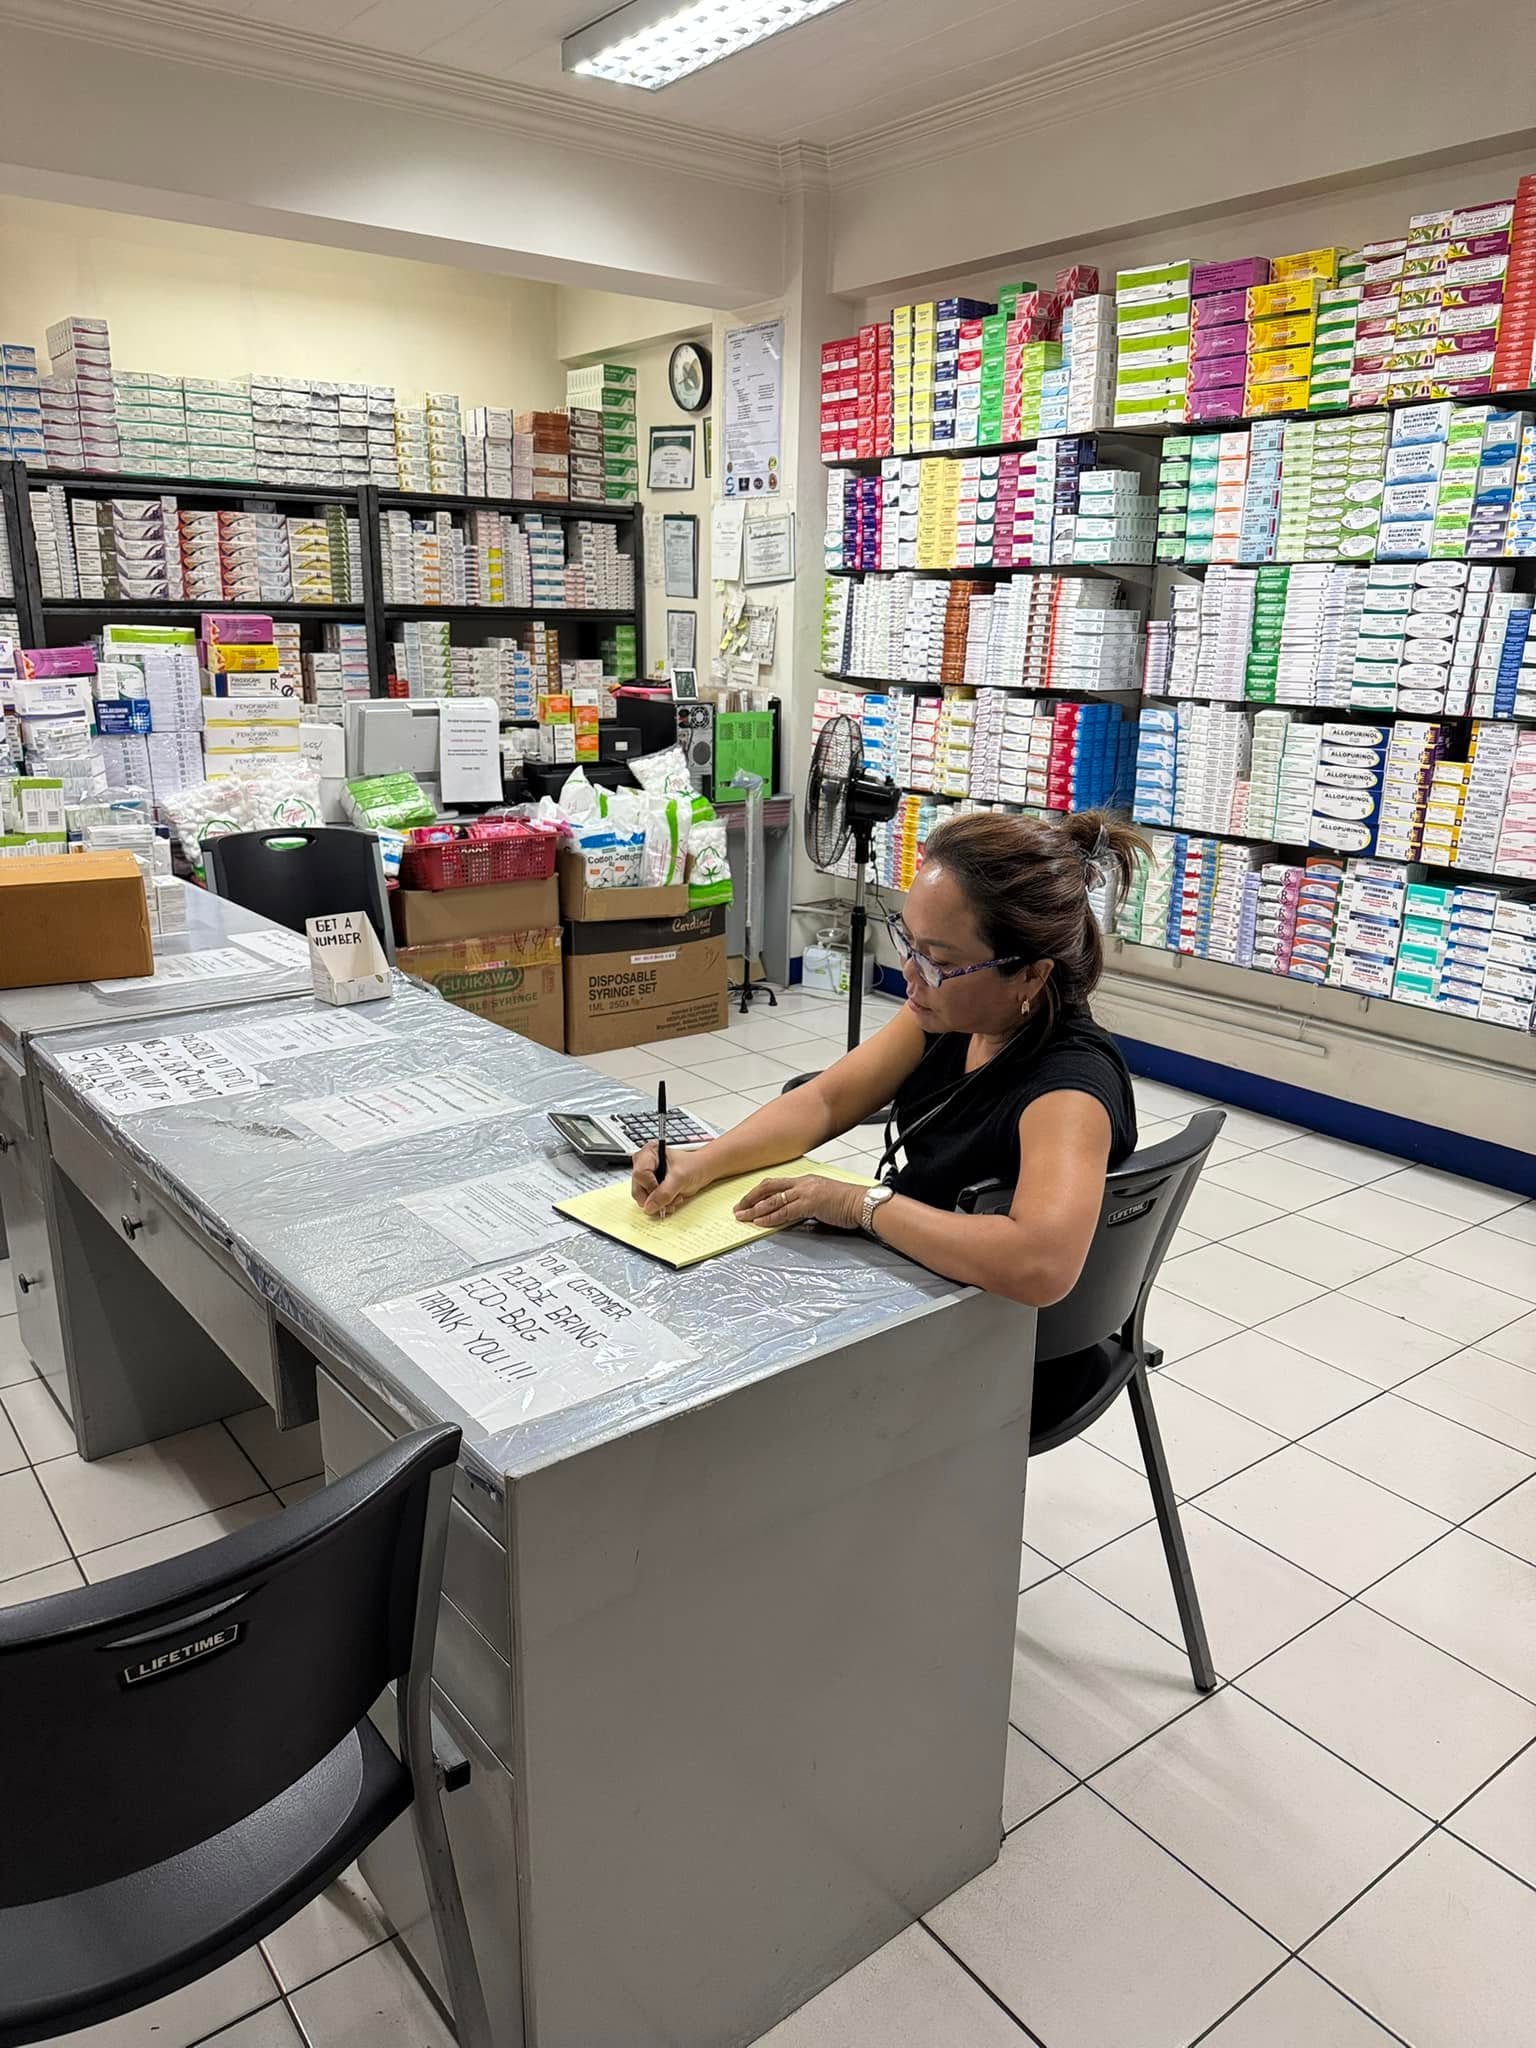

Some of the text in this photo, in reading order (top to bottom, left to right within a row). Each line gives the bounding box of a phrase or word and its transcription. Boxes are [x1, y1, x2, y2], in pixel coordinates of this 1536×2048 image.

[1333, 730, 1378, 739] ALLOPURINOL
[1331, 751, 1375, 760] ALLOPURINOL
[1327, 772, 1372, 781] ALLOPURINOL
[1325, 793, 1369, 803] ALLOPURINOL
[1321, 824, 1367, 834] ALLOPURINOL
[315, 917, 352, 933] GET A
[313, 932, 362, 947] NUMBER
[442, 970, 515, 992] FUJIKAWA
[589, 970, 657, 988] DISPOSABLE
[589, 982, 657, 1001] SYRINGE SET
[492, 992, 538, 1008] SYRINGE
[1112, 1202, 1145, 1221] LIFETIME
[536, 1255, 557, 1267] TO
[416, 1290, 473, 1333] THANK
[459, 1277, 550, 1342] ECO-BAG
[497, 1266, 608, 1349] PLEASE BRING
[139, 1631, 225, 1675] LIFETIME
